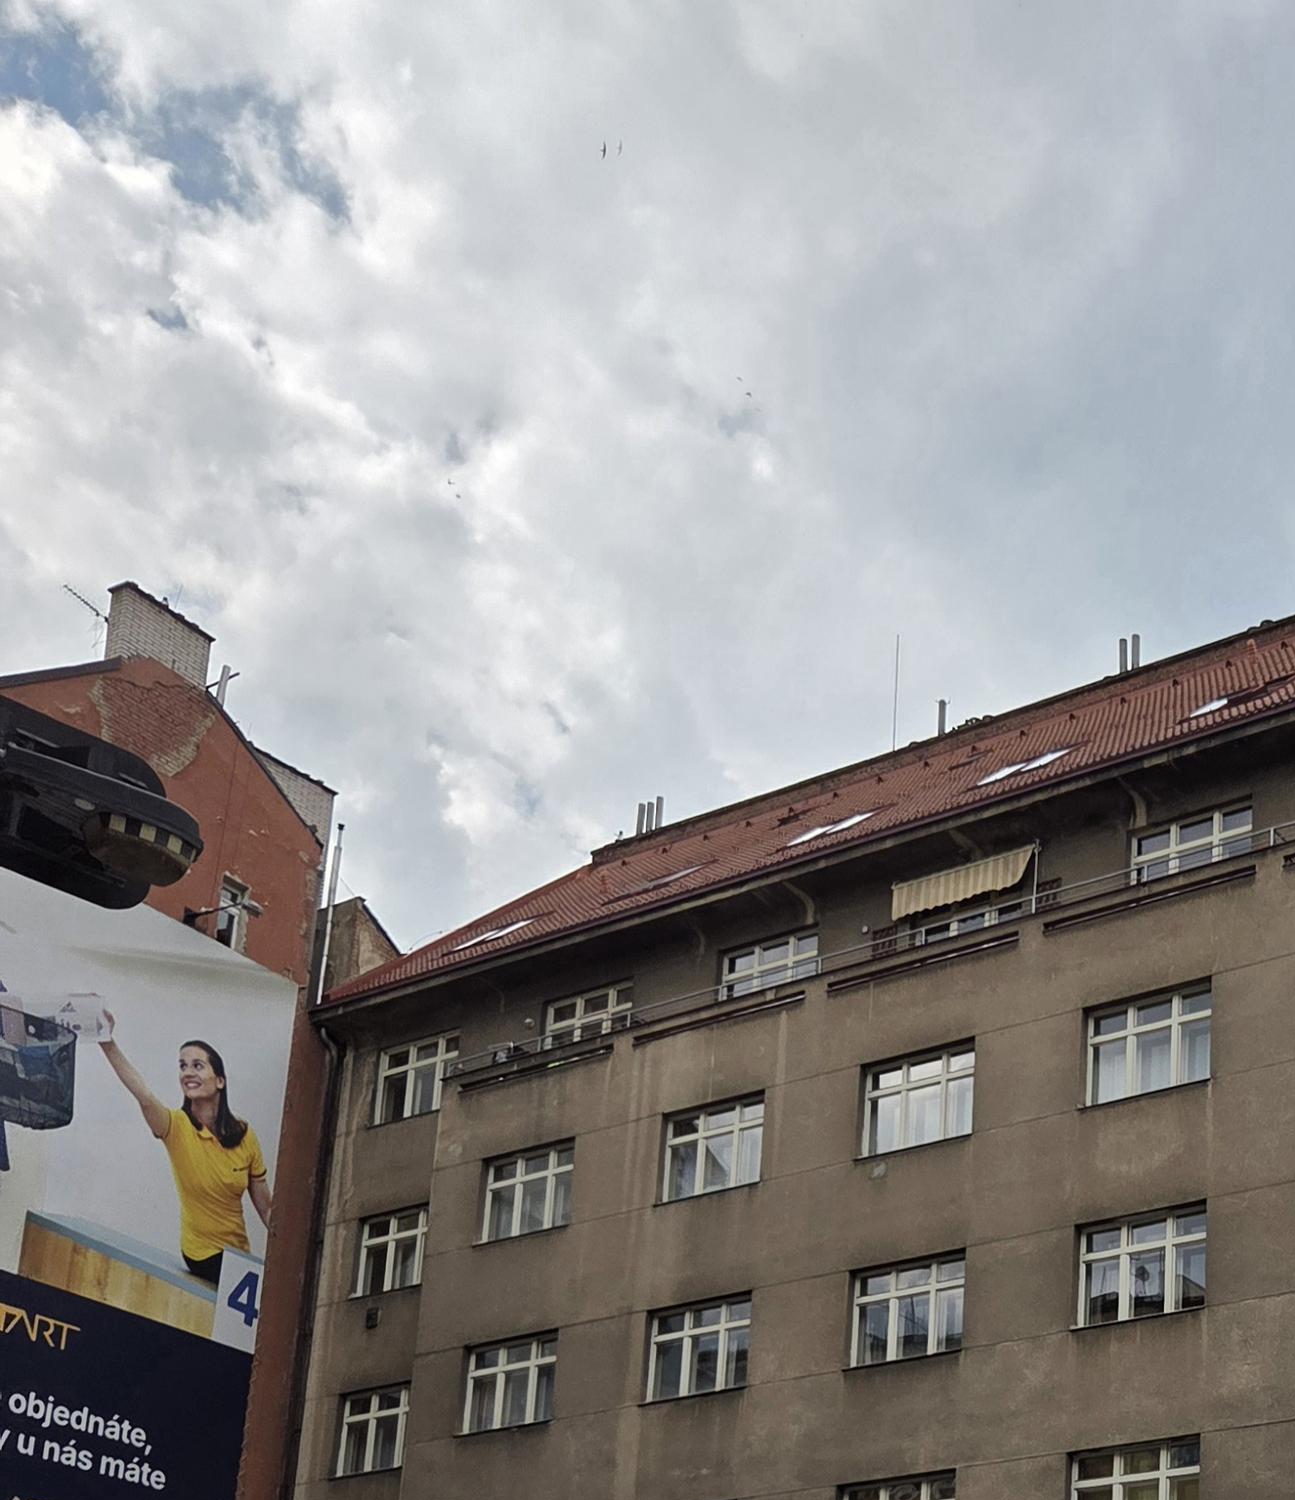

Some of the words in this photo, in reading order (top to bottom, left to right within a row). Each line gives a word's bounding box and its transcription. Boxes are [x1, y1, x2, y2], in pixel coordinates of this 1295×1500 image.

[226, 1271, 259, 1327] 4
[8, 1391, 152, 1456] objednáte,
[17, 1433, 36, 1456] u
[42, 1439, 93, 1471] nás
[99, 1456, 166, 1490] máte
